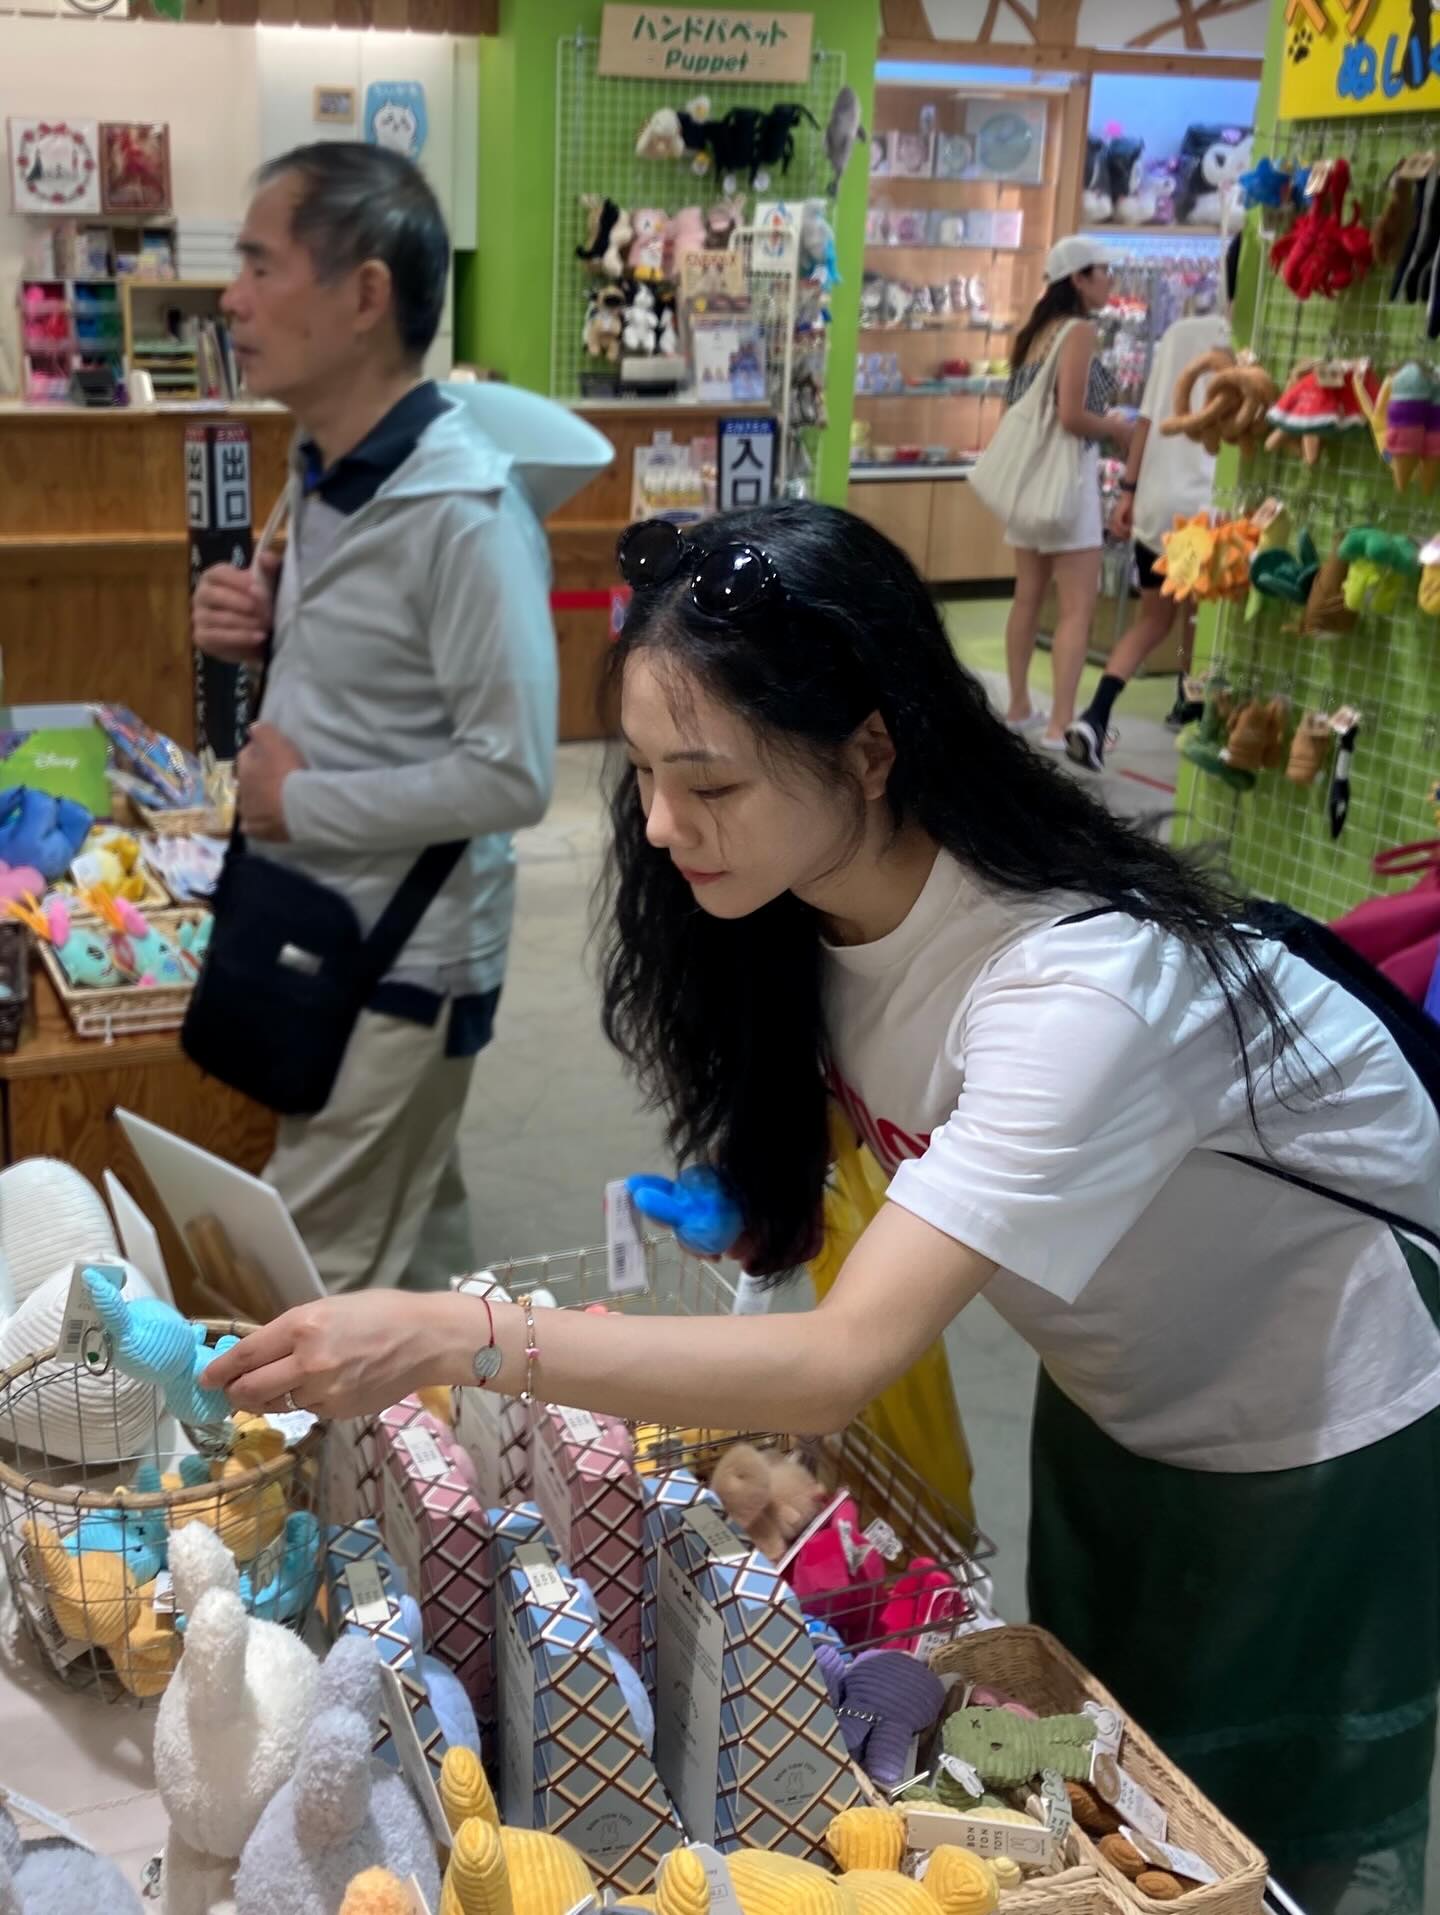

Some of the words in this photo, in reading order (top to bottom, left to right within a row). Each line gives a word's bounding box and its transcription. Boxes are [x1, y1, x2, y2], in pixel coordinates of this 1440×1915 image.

[664, 47, 749, 73] Puppet
[1337, 33, 1440, 100] ぬい
[222, 446, 247, 522] 出口
[731, 438, 764, 506] 入口
[966, 1826, 976, 1848] BON
[980, 1828, 989, 1849] TON
[994, 1830, 1003, 1851] TOYS
